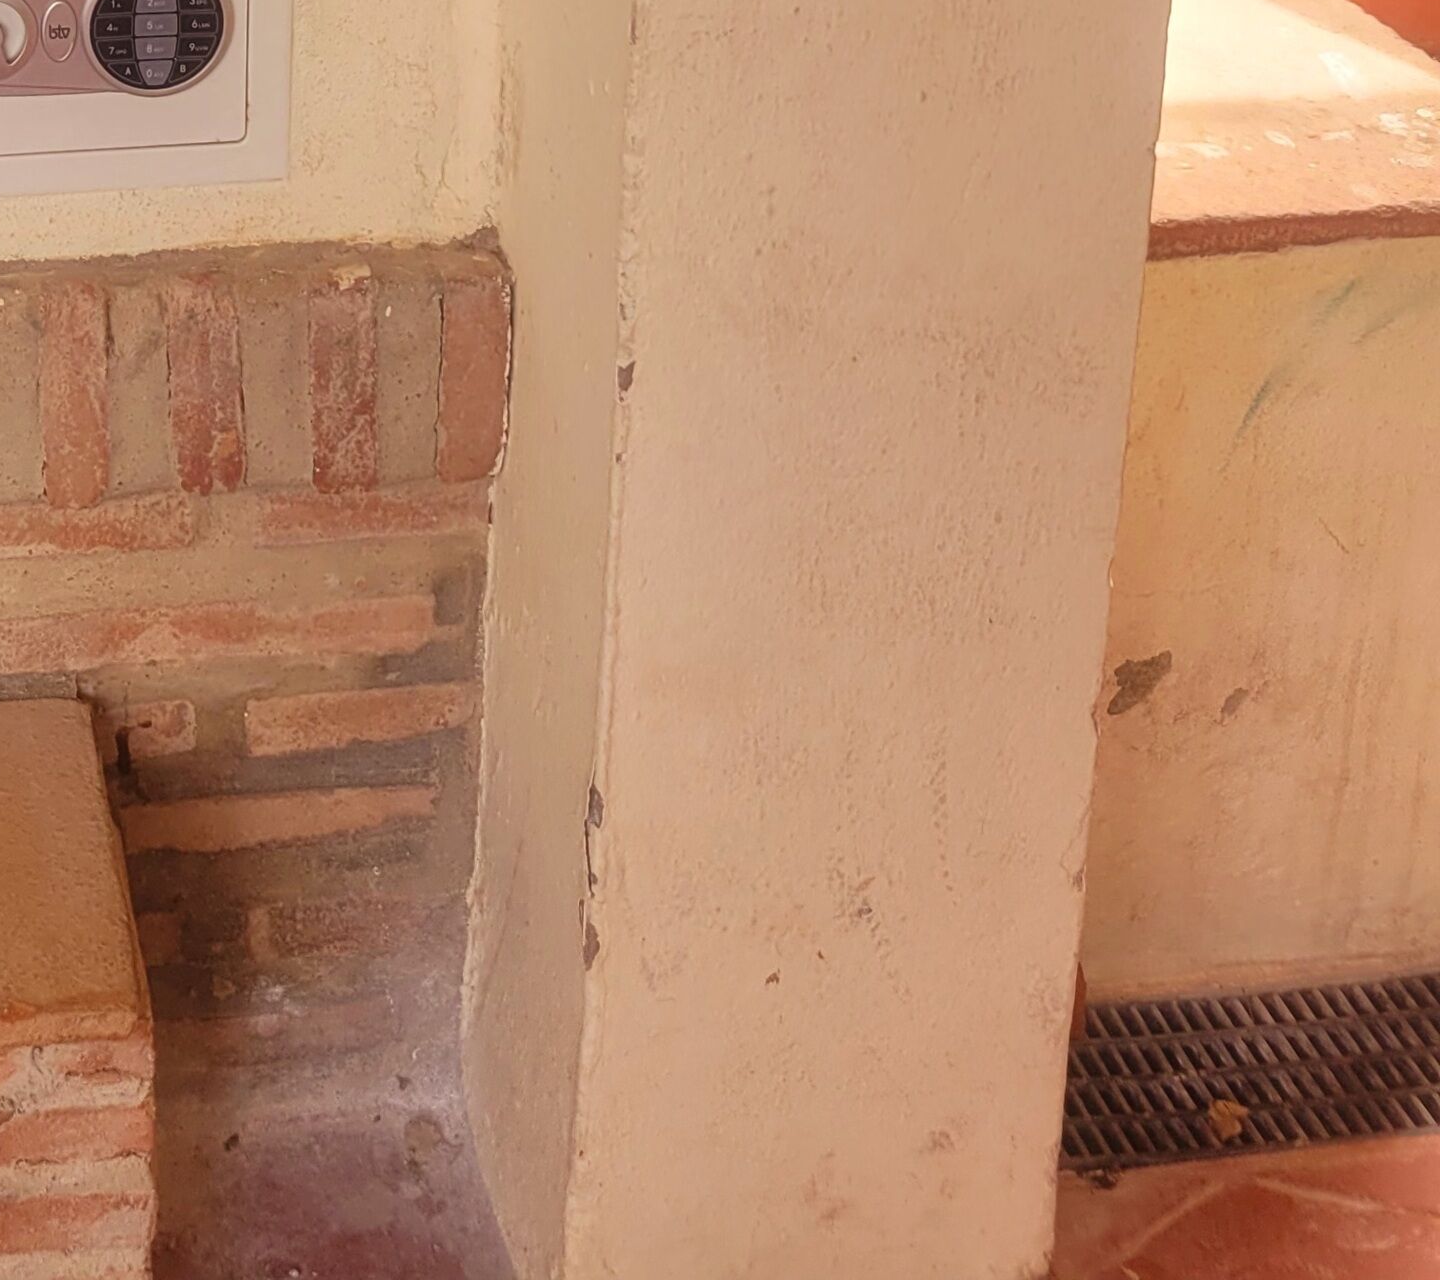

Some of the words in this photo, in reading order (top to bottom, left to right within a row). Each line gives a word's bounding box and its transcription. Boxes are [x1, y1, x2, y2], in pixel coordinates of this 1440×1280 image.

[48, 24, 71, 39] btv
[106, 23, 113, 31] 4
[147, 20, 153, 30] 5
[191, 20, 197, 29] 6
[189, 42, 194, 51] 9
[125, 66, 131, 76] A
[180, 63, 186, 72] B
